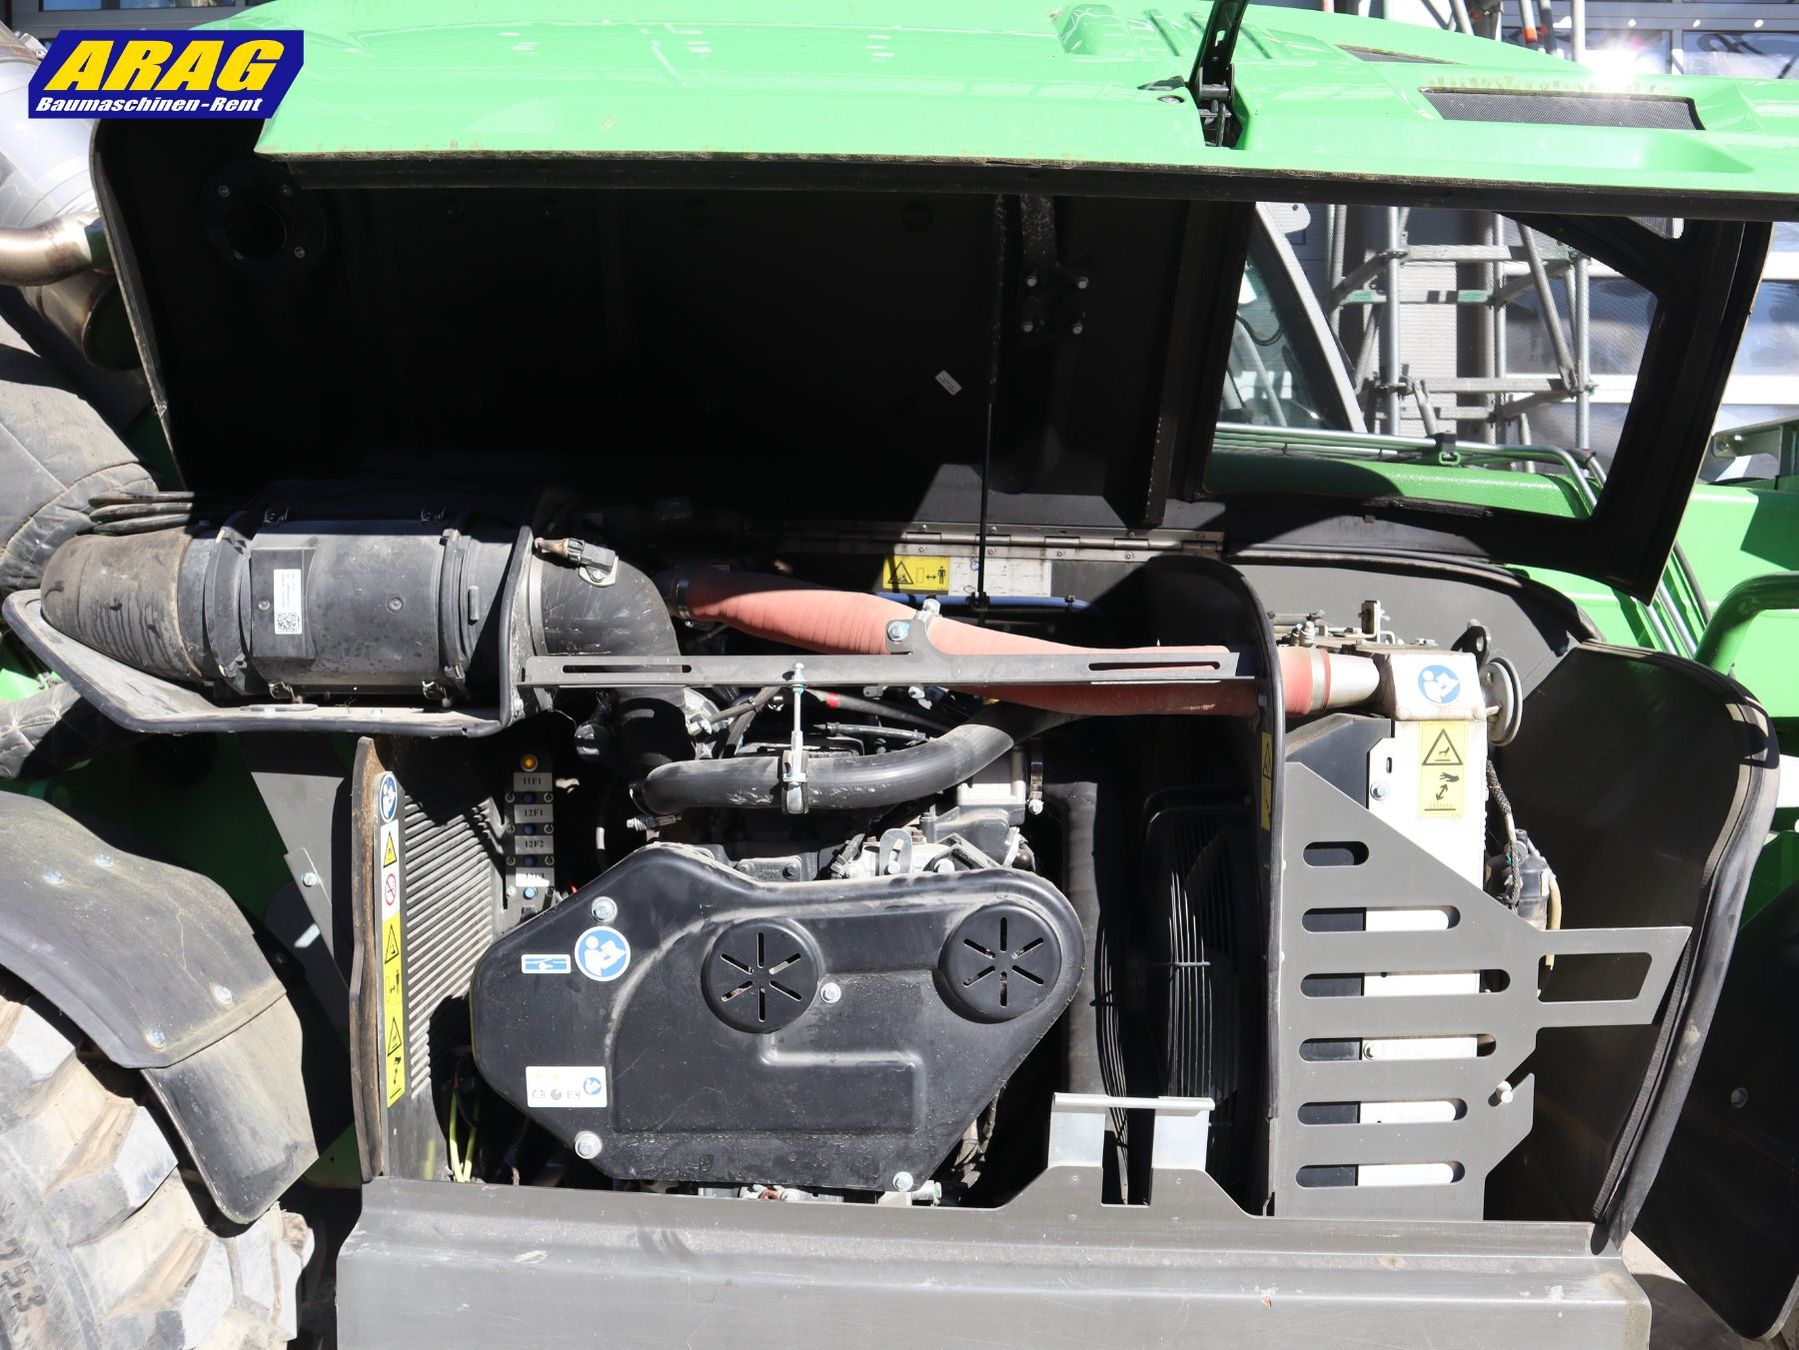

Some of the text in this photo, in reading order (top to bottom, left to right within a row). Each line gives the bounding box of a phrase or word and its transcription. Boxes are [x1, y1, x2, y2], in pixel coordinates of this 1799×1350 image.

[523, 777, 541, 785] 11F1
[524, 808, 543, 816] 12F1
[525, 839, 544, 848] 12F2
